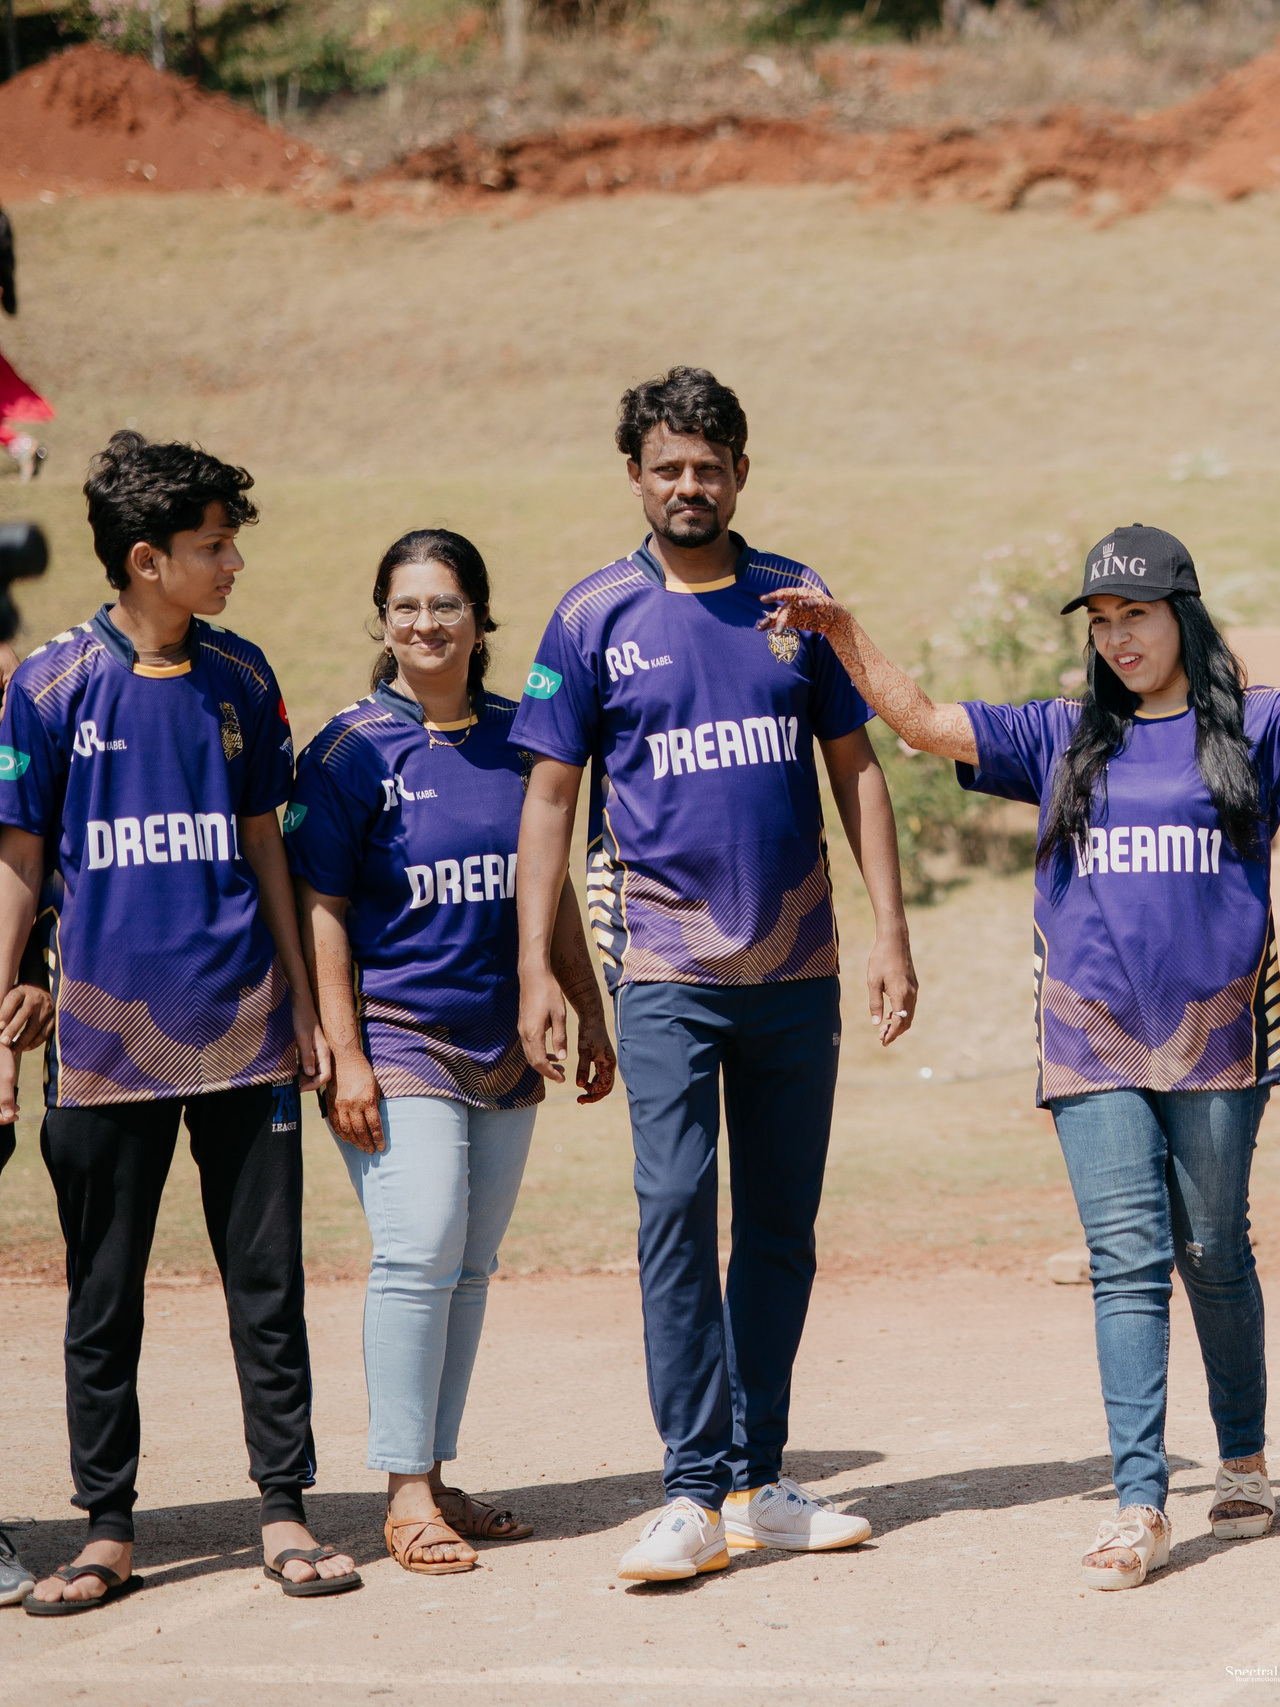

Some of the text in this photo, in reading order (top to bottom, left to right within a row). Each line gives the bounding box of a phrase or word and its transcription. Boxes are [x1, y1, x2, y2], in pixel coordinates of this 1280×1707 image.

[1090, 556, 1147, 582] KING
[650, 655, 674, 669] KABEL
[106, 740, 128, 751] KABEL
[645, 716, 798, 780] DREAM11
[416, 789, 438, 800] KABEL
